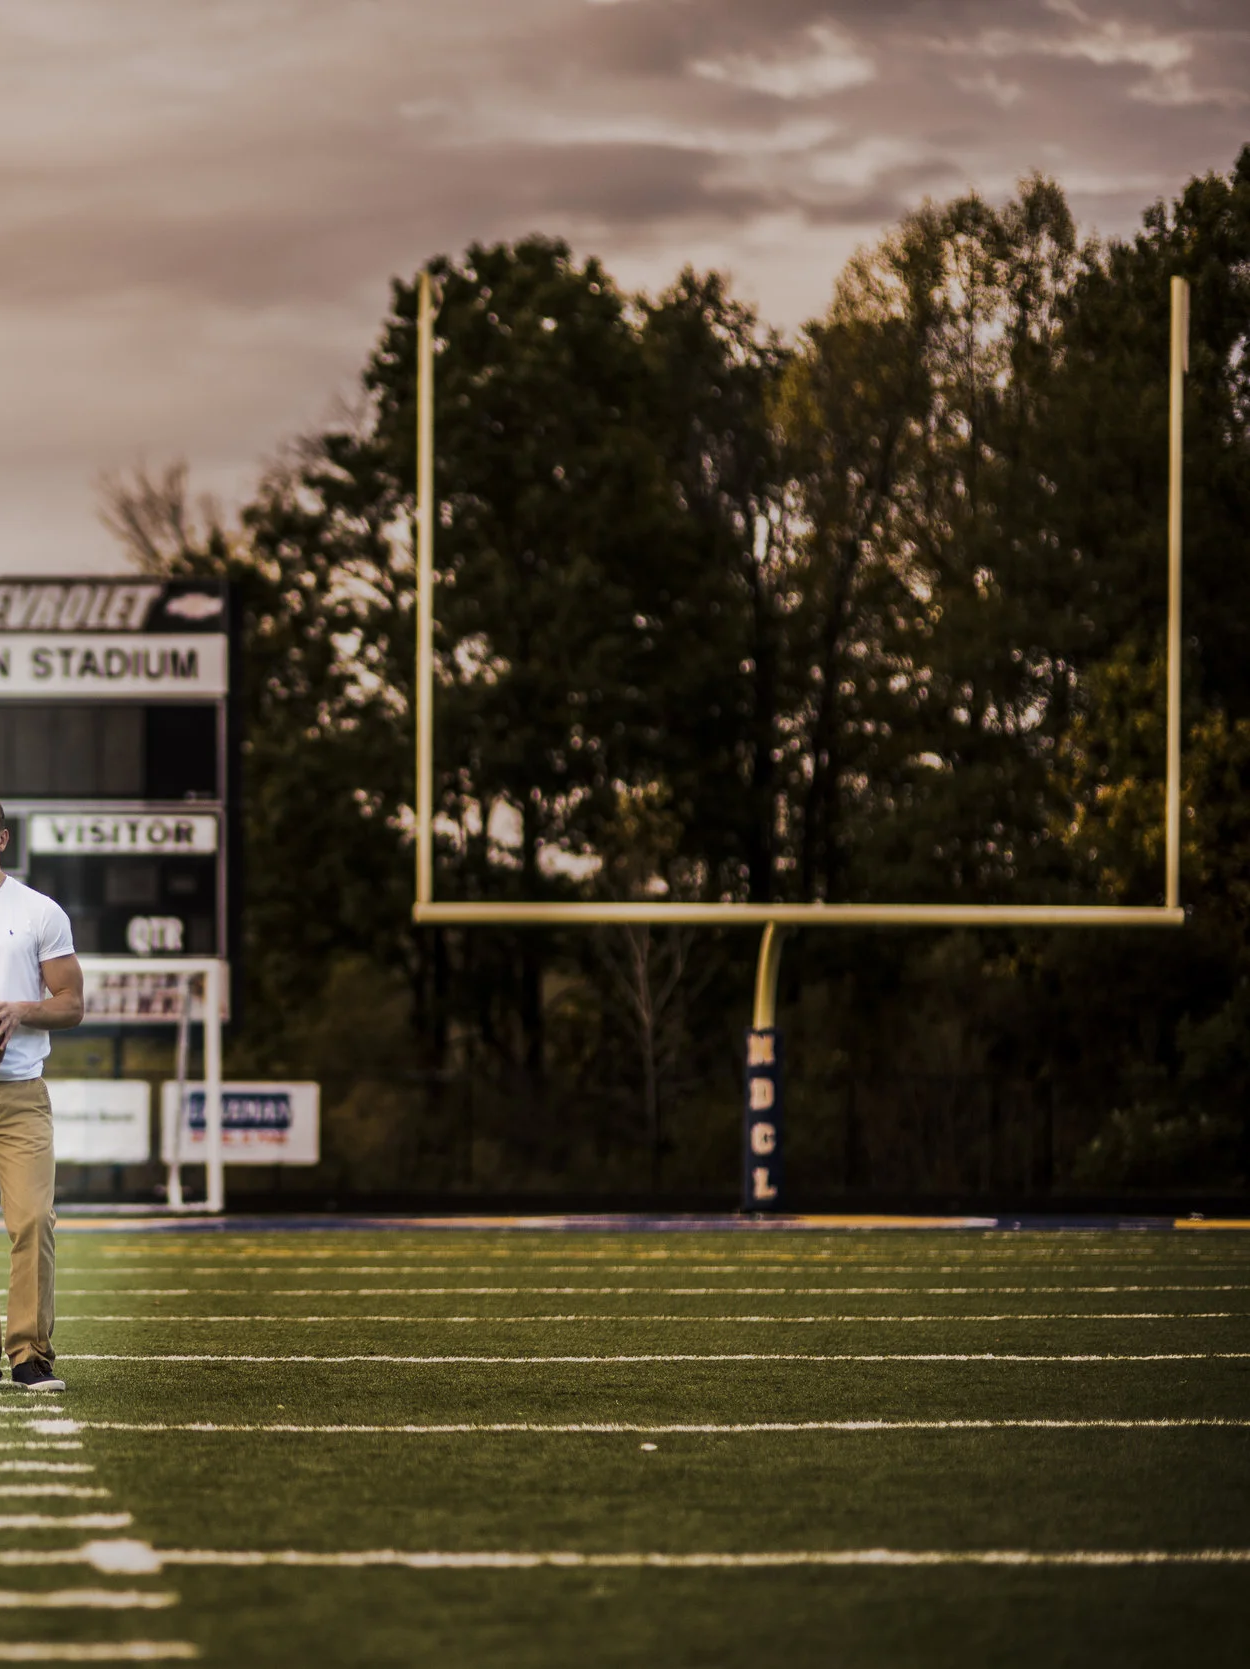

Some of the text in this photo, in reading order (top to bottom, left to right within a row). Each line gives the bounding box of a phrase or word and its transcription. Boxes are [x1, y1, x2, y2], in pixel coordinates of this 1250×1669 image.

[33, 648, 199, 679] STADIUM
[52, 820, 195, 844] VISITOR
[127, 916, 184, 956] QTR
